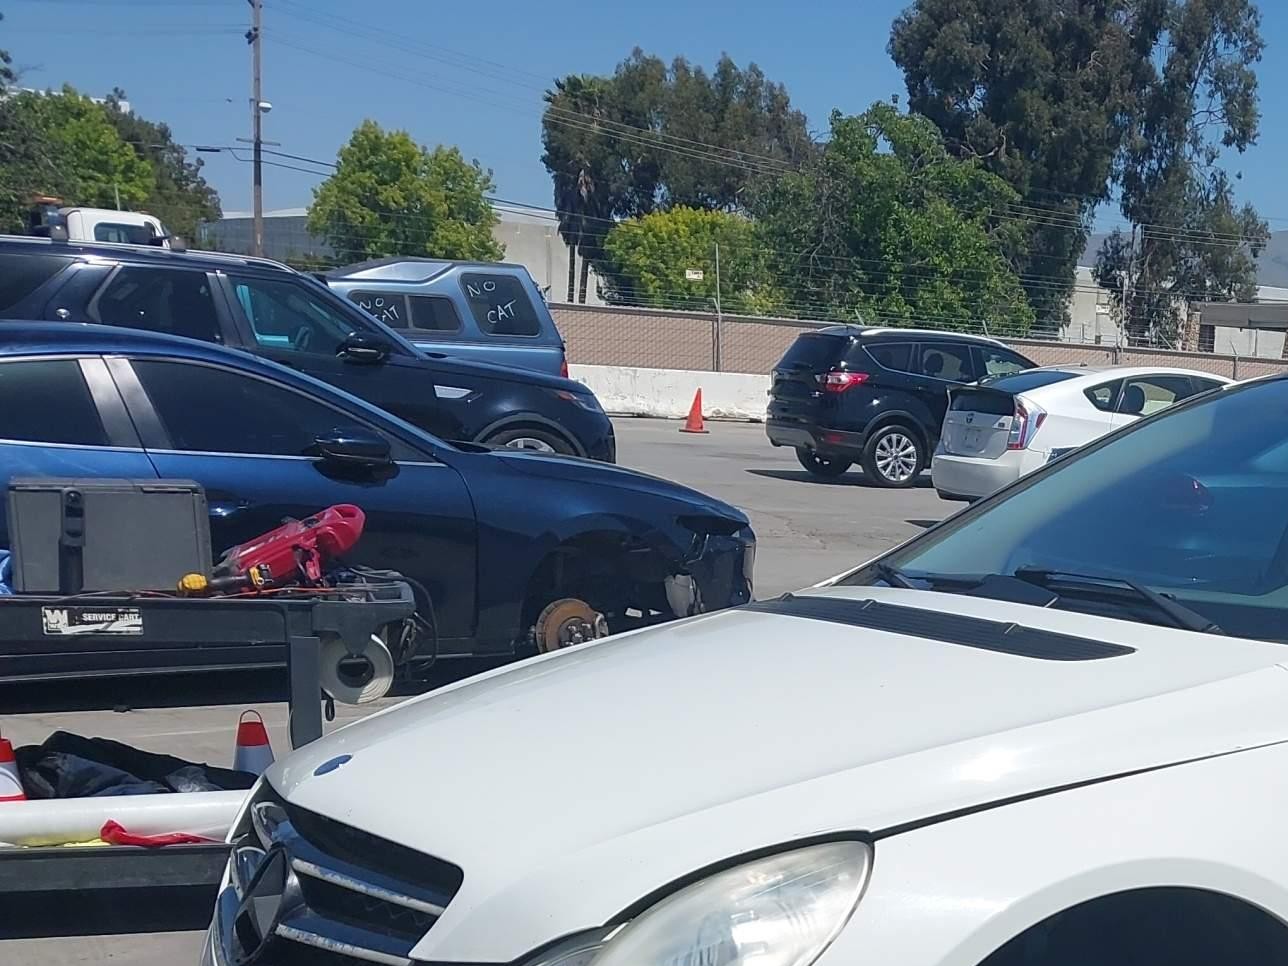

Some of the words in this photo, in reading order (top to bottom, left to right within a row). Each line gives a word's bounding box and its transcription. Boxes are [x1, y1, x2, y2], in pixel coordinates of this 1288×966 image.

[467, 281, 496, 298] NO
[359, 297, 385, 310] NO
[487, 299, 518, 324] CAT
[373, 304, 400, 322] AT
[82, 613, 116, 621] SERVICE
[118, 613, 140, 621] CART
